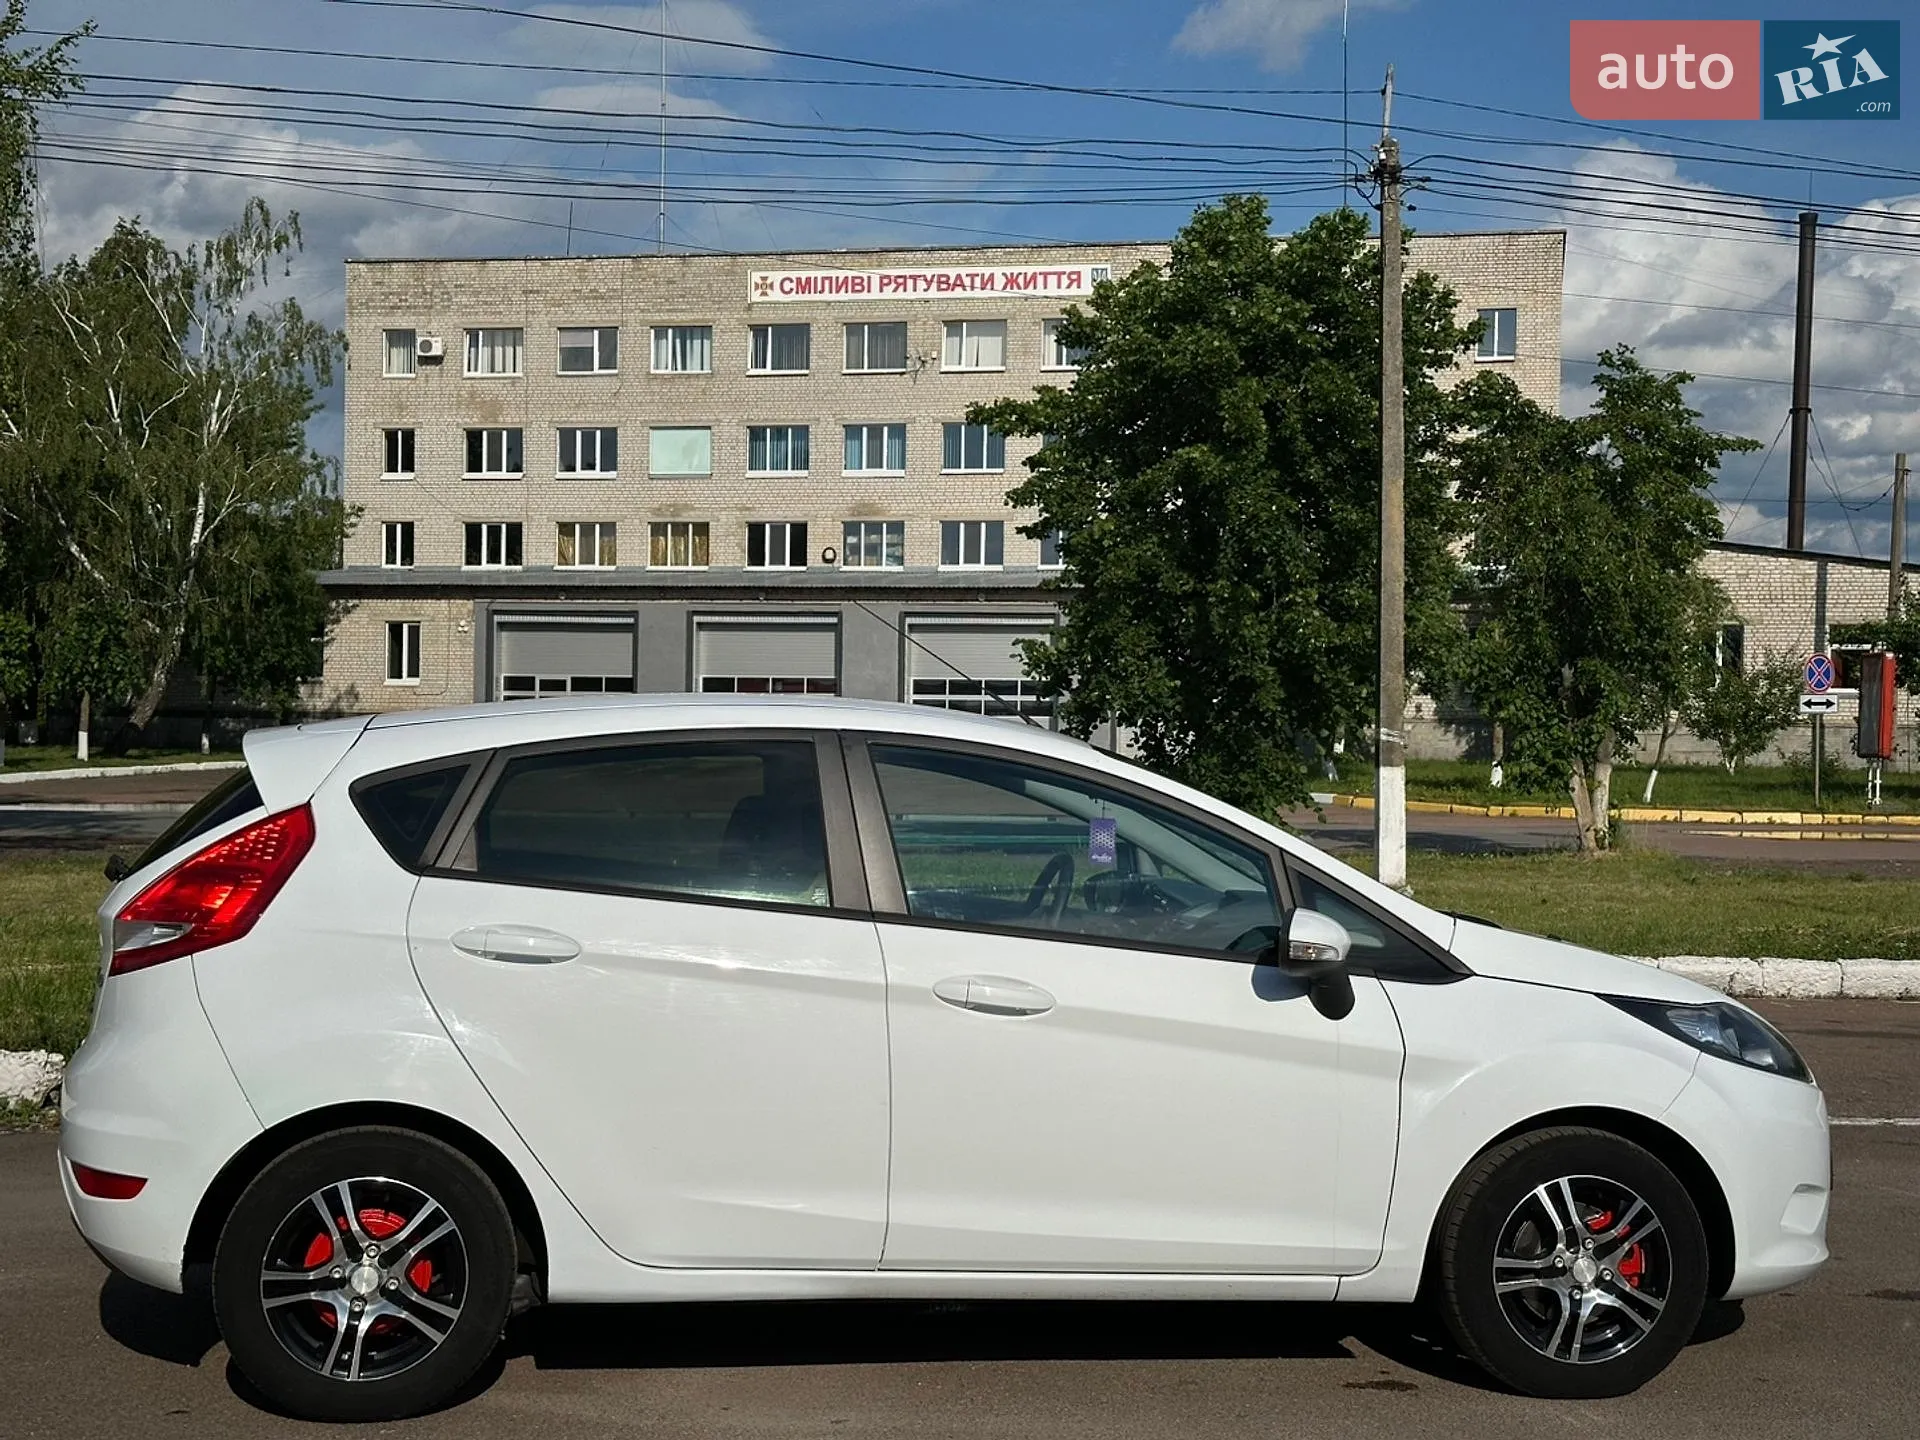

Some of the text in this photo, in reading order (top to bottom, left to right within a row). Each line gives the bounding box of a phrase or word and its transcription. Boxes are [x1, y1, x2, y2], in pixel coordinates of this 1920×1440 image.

[779, 270, 1082, 295] СМІЛИВІ РЯТУВАТИ ЖИТТЯ
